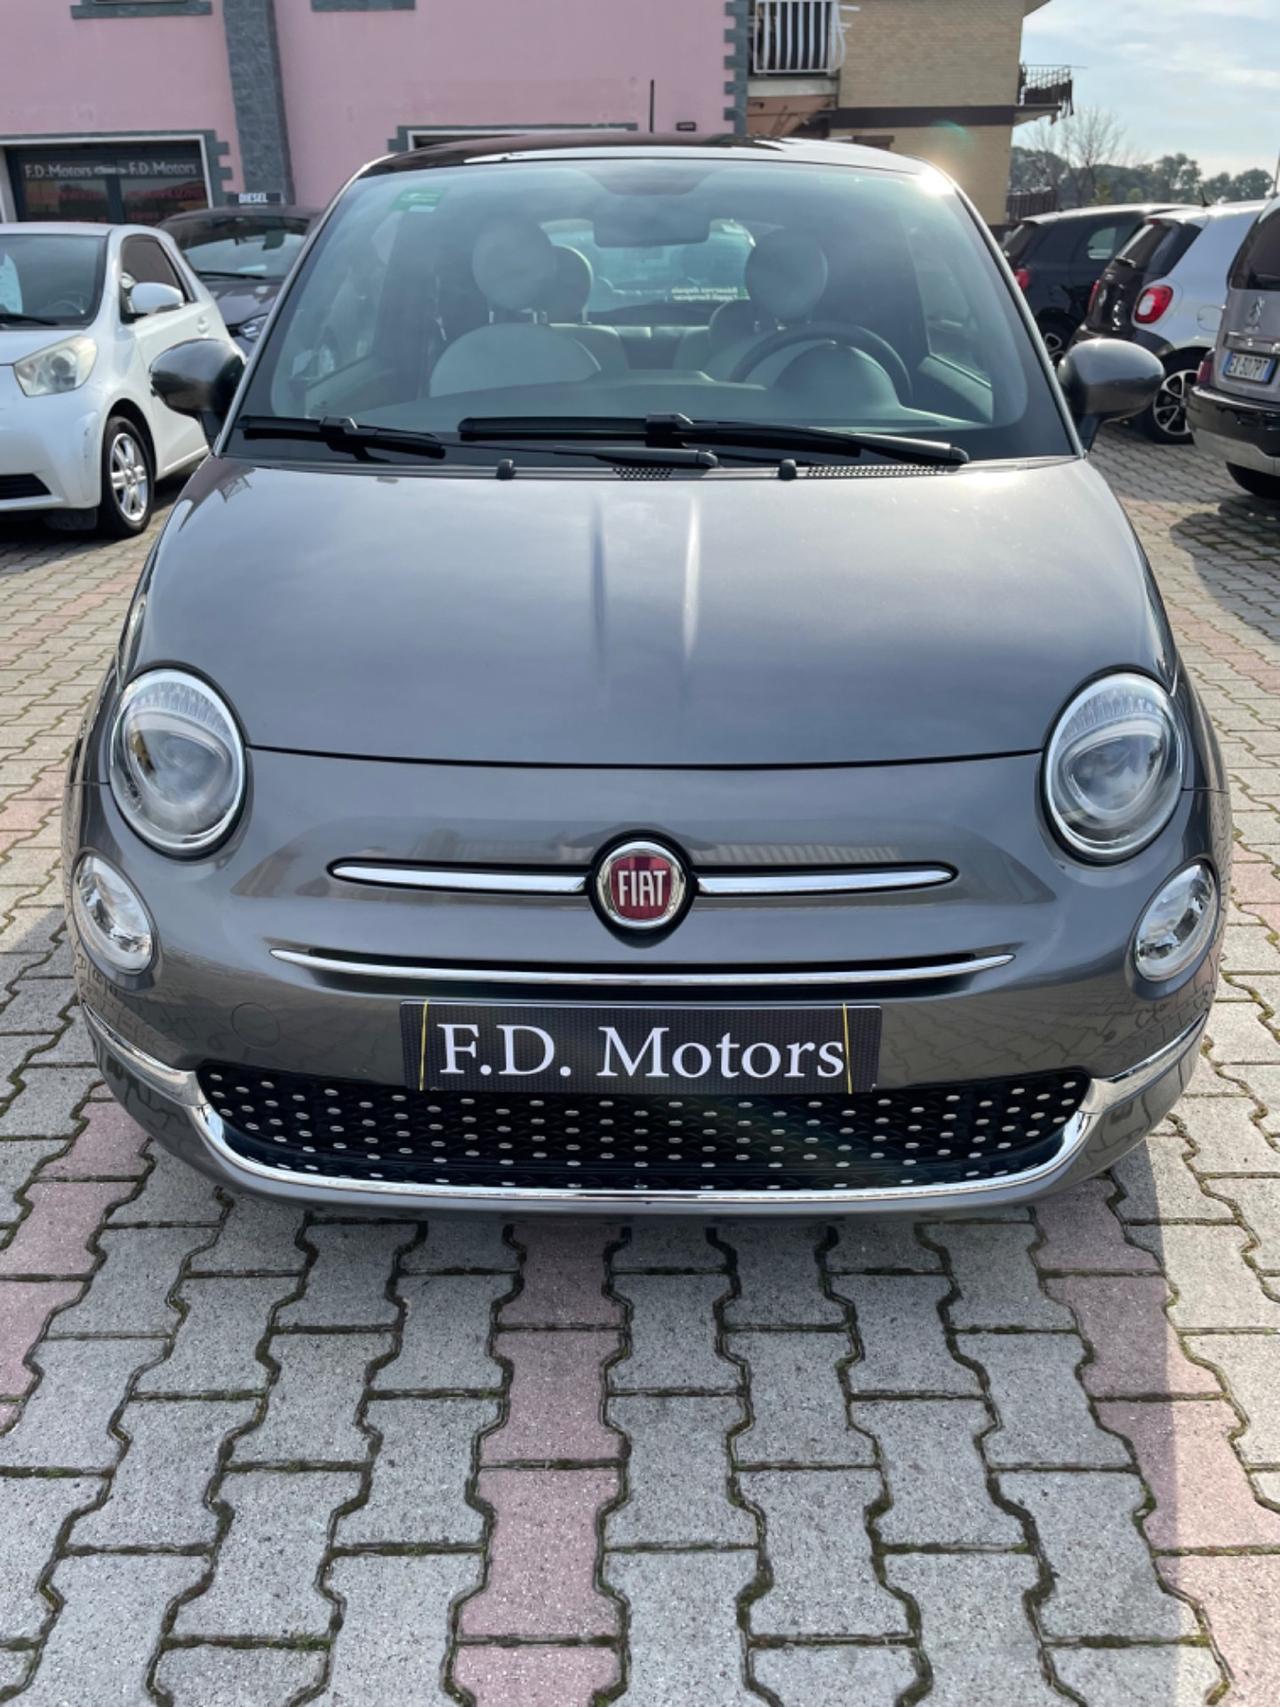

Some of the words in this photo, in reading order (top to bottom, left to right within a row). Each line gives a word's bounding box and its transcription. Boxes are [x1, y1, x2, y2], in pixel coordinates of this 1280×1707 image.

[618, 870, 667, 907] FIAT
[437, 1022, 572, 1077] F.D.
[596, 1026, 845, 1079] Motors
